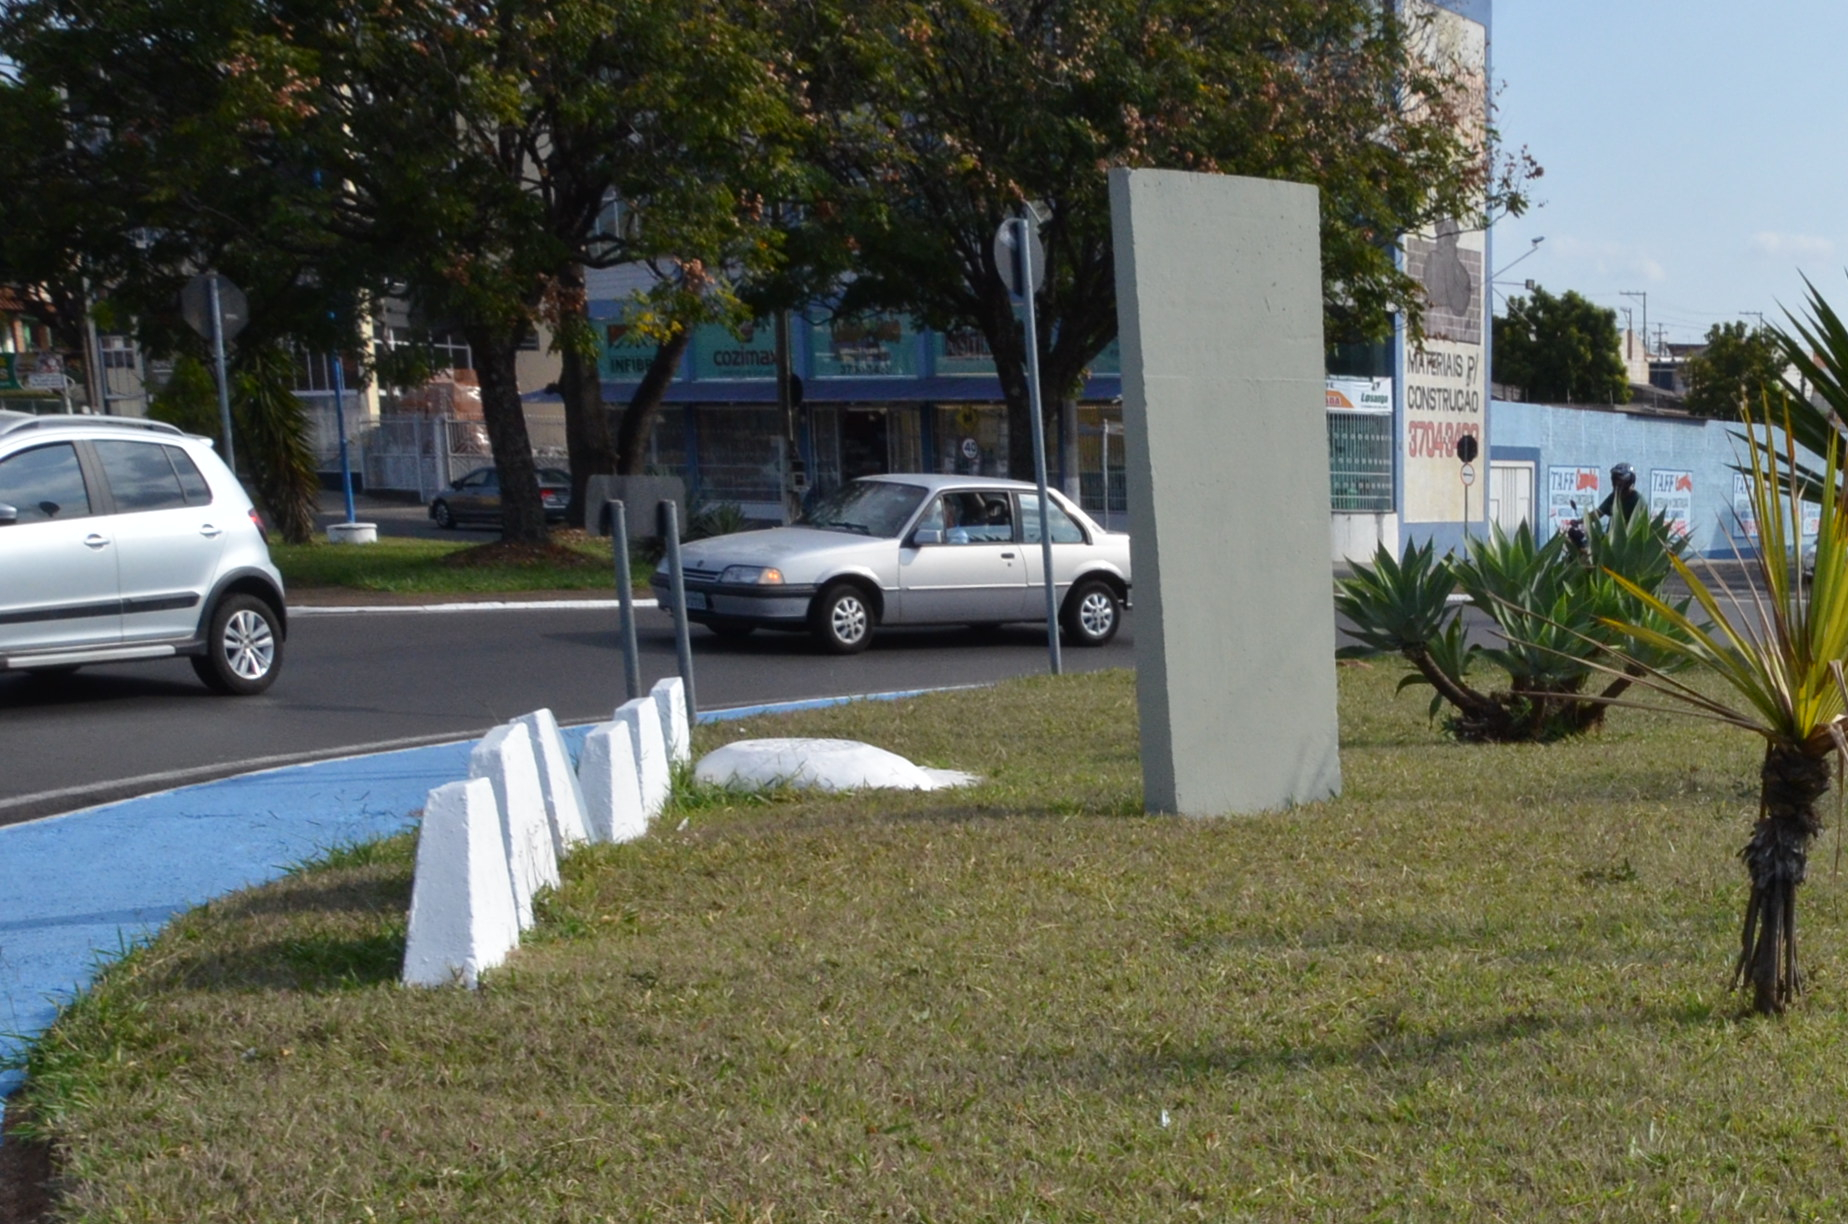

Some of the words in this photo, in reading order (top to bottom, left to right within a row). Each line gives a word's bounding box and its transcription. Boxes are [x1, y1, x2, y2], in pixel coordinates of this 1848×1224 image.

[964, 442, 976, 453] 40
[1551, 471, 1574, 491] TAFF
[1652, 472, 1674, 493] TAFF
